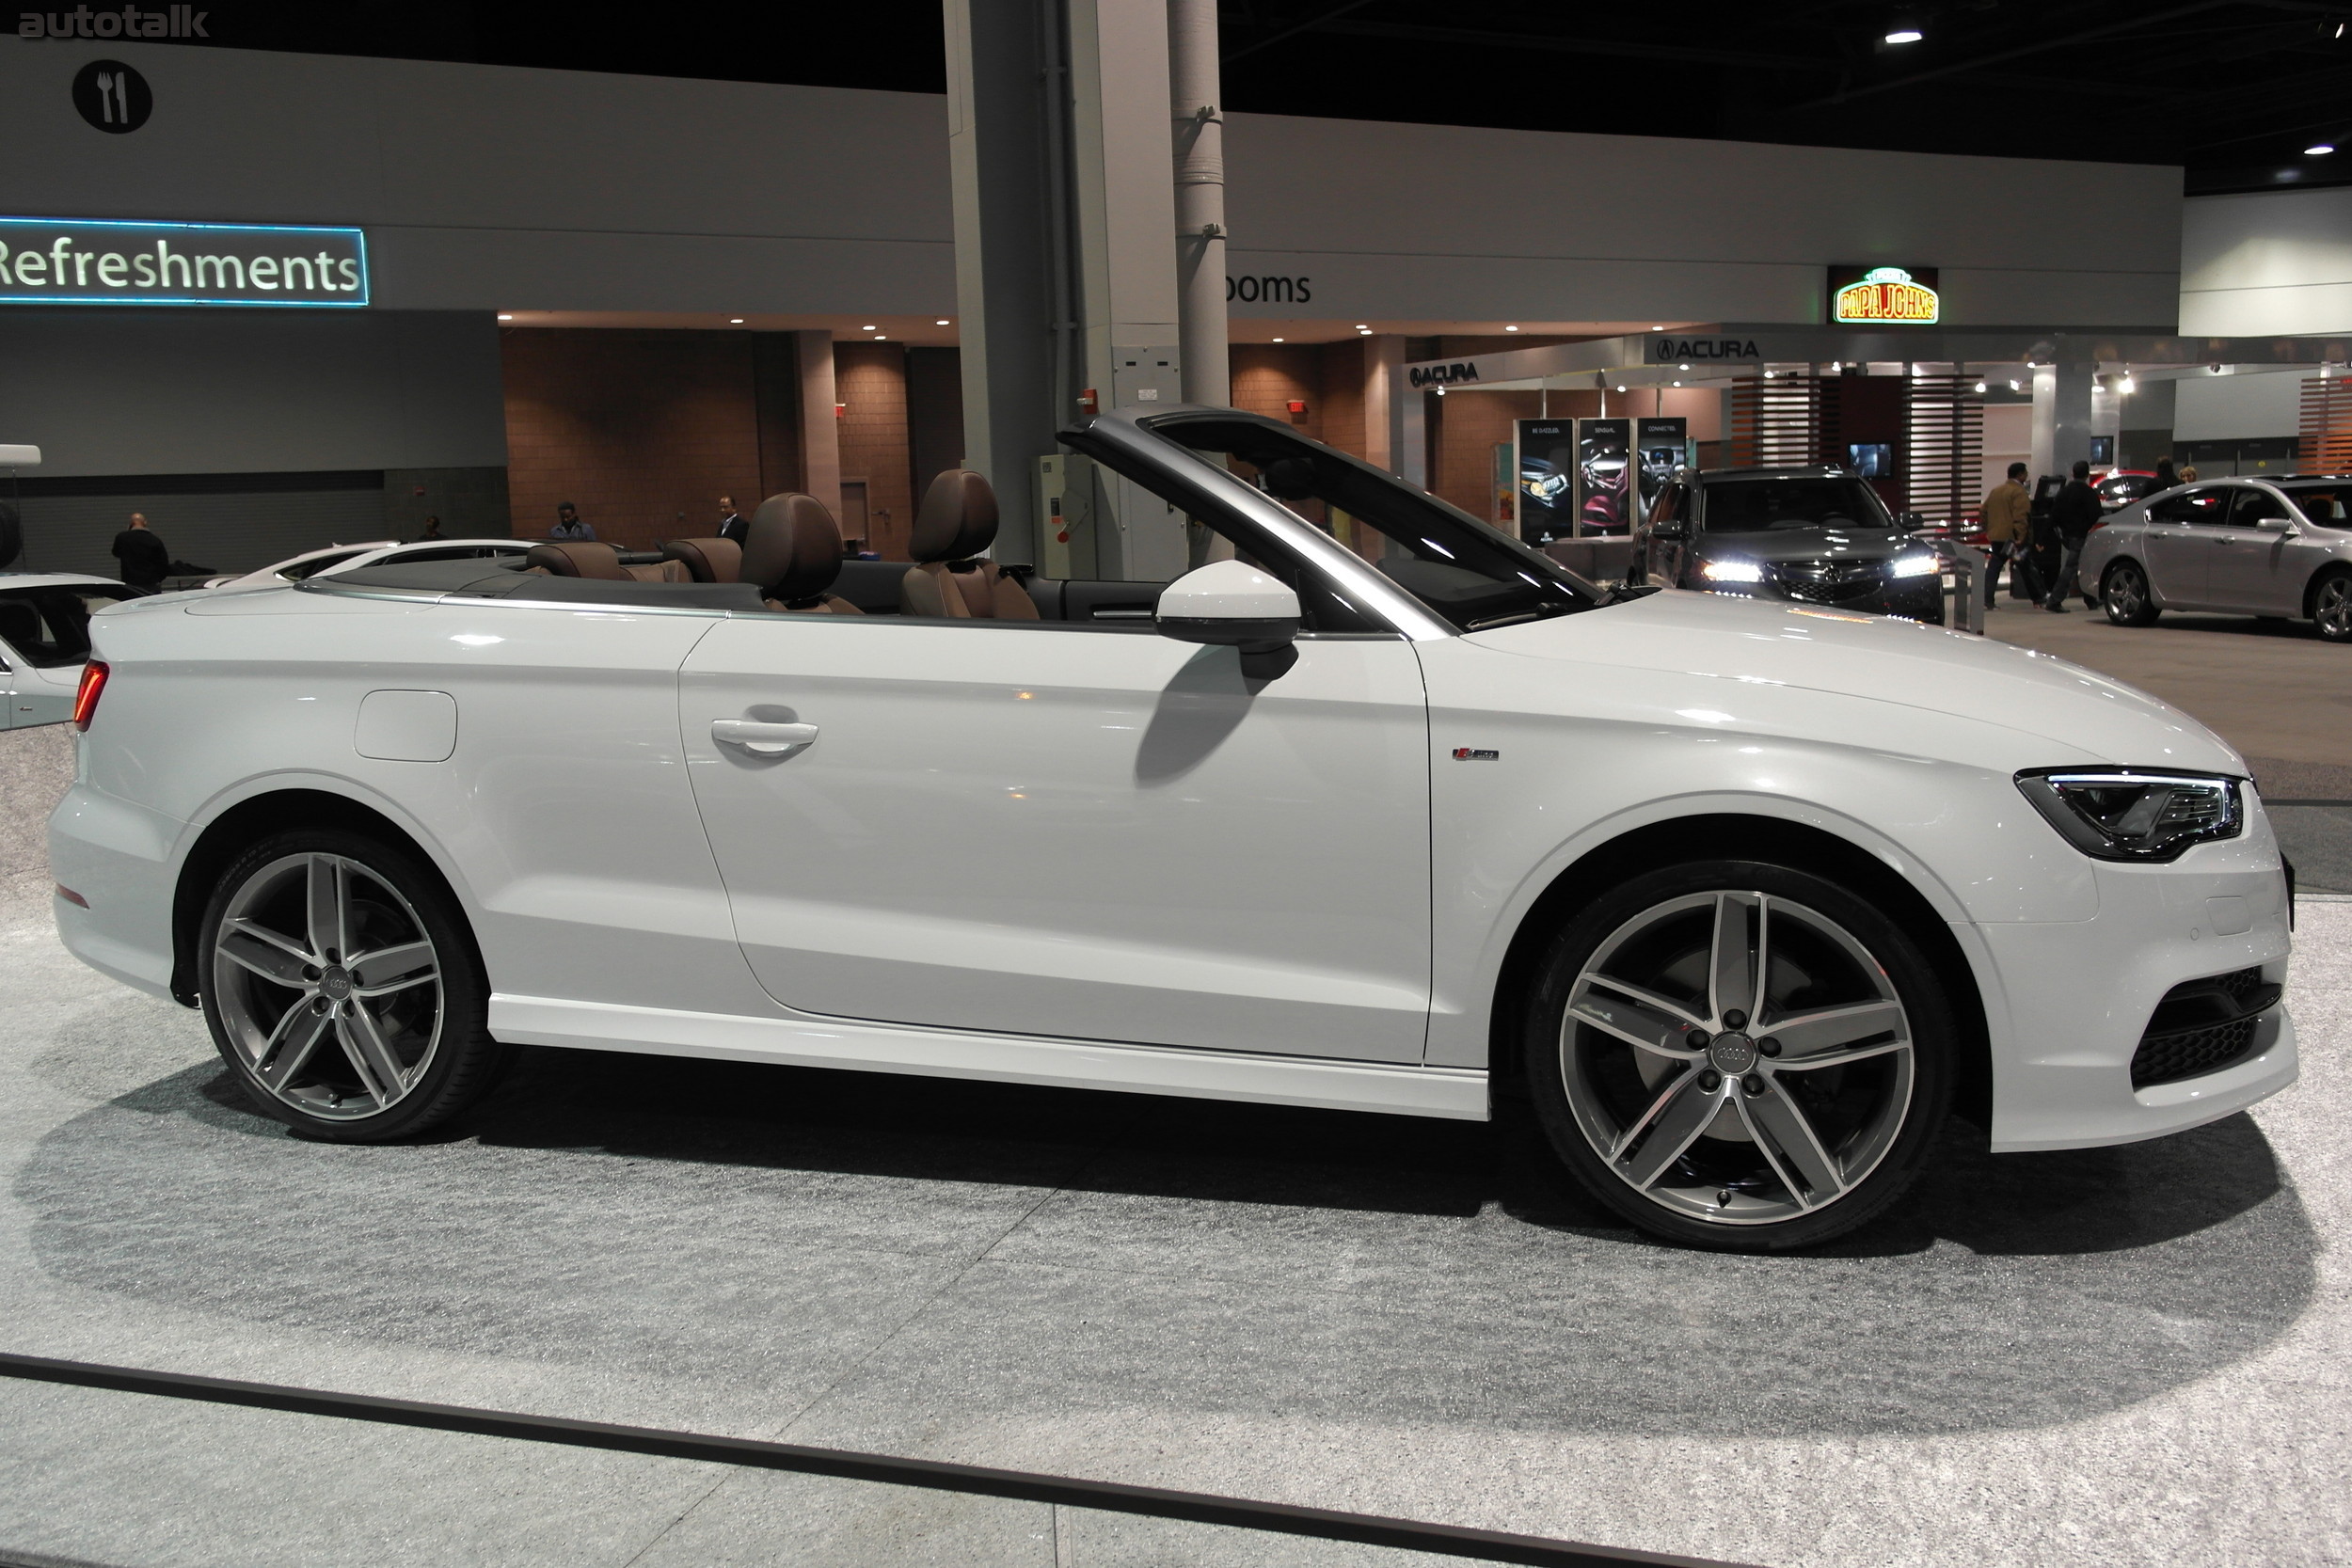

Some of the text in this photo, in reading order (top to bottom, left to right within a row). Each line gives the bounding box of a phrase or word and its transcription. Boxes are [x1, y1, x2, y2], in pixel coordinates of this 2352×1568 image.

[1840, 285, 1883, 318] PAPA
[1675, 340, 1759, 358] ACURA
[1420, 362, 1480, 386] ACURA
